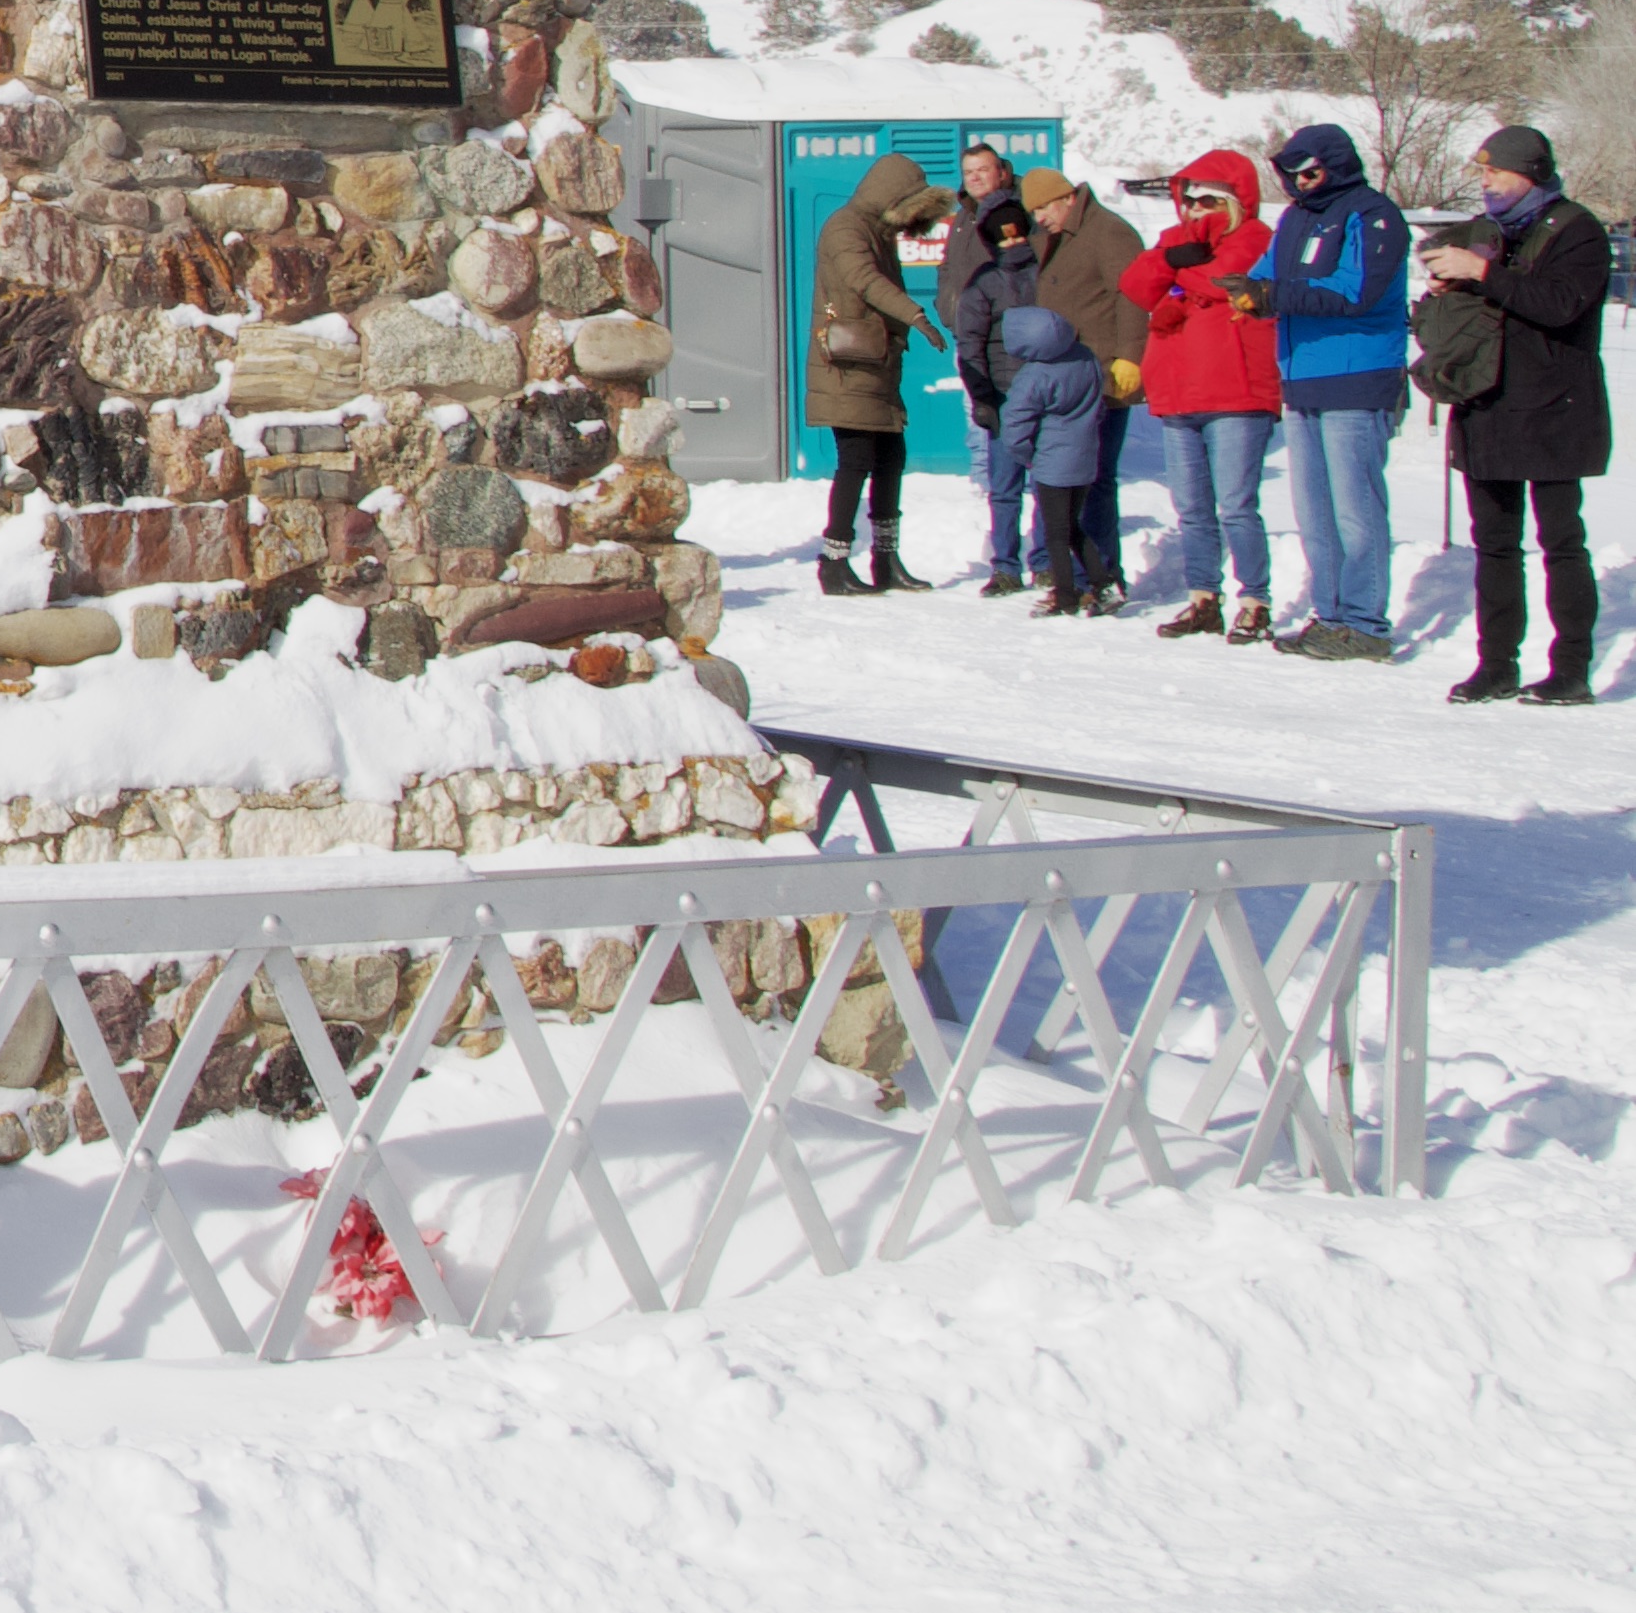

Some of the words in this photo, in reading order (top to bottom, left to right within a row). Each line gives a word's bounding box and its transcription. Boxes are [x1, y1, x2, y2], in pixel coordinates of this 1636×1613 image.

[206, 0, 241, 12] Christ
[247, 1, 259, 12] of
[265, 1, 322, 17] Latter-day
[100, 12, 140, 26] Saints,
[146, 13, 212, 27] established
[218, 18, 226, 27] a
[232, 16, 275, 31] thriving
[281, 18, 324, 33] farming
[101, 28, 166, 44] community
[173, 31, 212, 43] known
[219, 34, 233, 43] as
[240, 32, 296, 46] Washakie,
[303, 34, 325, 46] and
[103, 47, 136, 60] many
[137, 46, 177, 61] helped
[179, 47, 208, 59] build
[210, 48, 229, 59] the
[231, 48, 267, 63] Logan
[268, 49, 312, 64] Temple.
